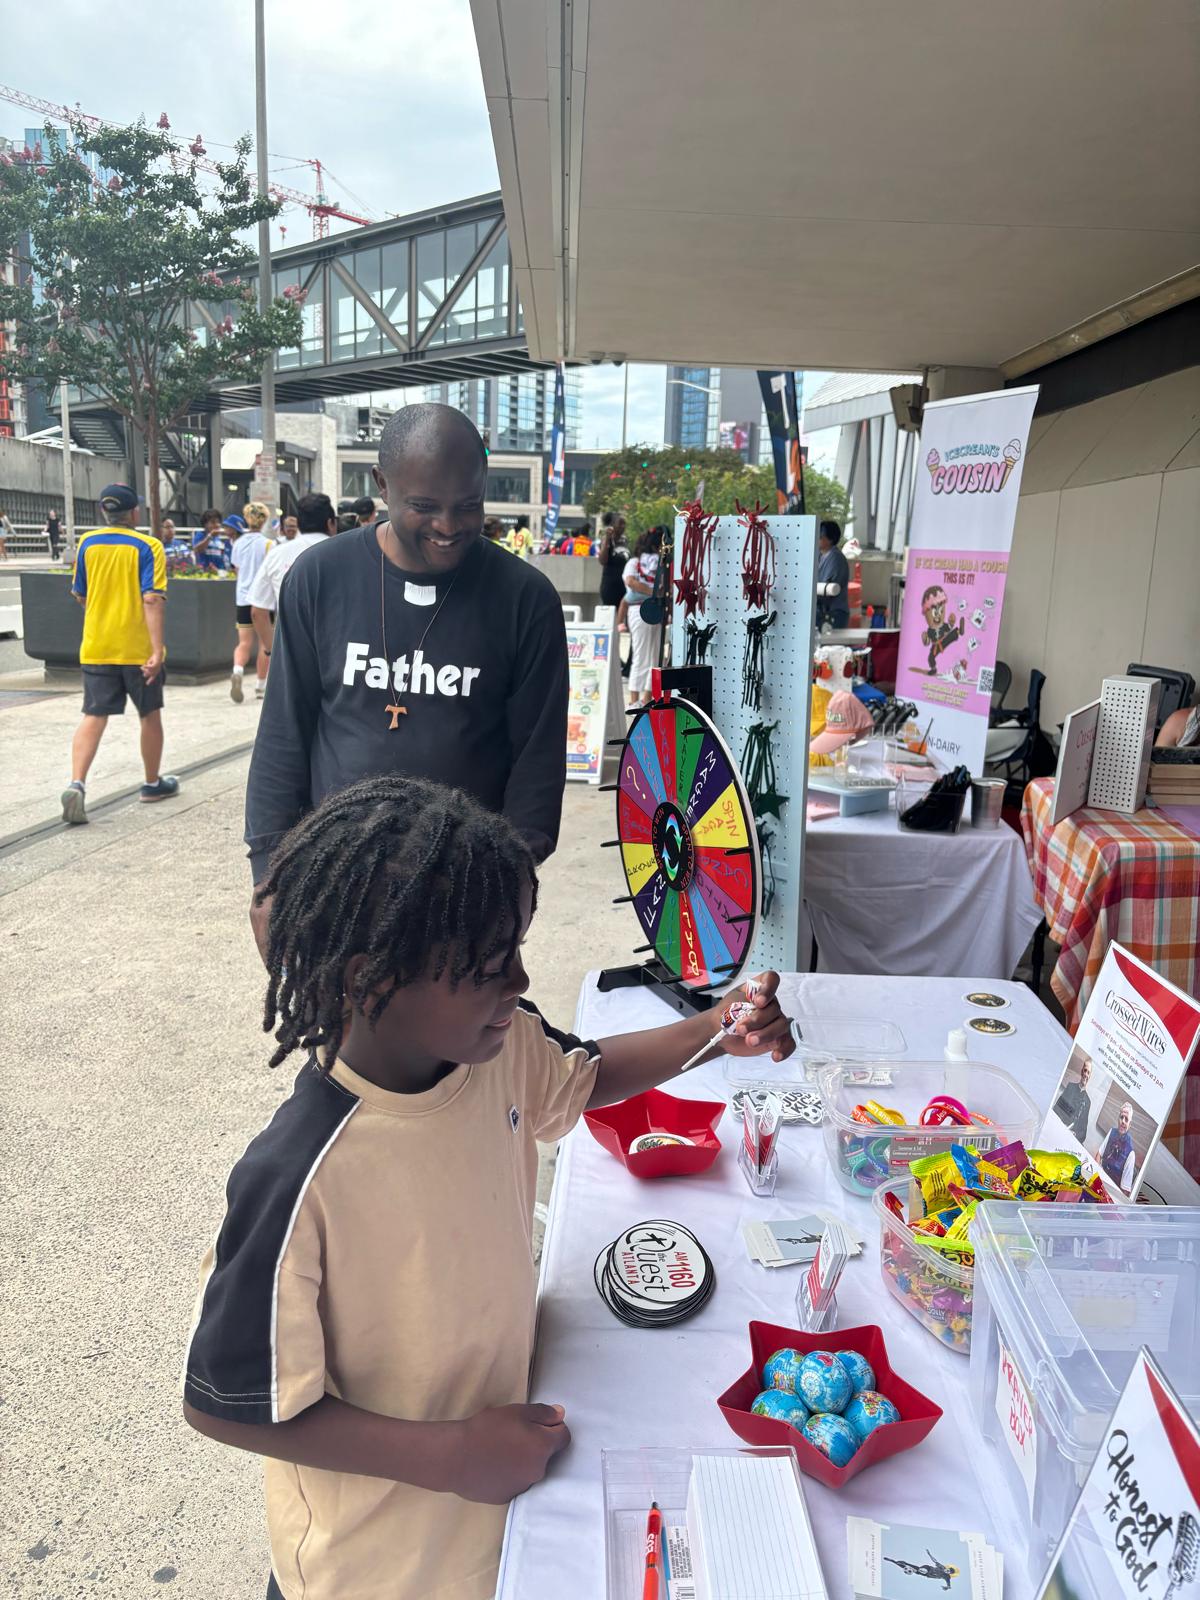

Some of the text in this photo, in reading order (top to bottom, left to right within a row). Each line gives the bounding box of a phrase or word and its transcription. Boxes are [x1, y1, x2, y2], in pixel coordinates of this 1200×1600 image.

[944, 444, 1000, 462] ICECREAM'S
[931, 462, 1007, 495] COUSIN
[943, 572, 958, 584] THIS
[958, 573, 966, 585] IS
[342, 642, 481, 697] Father
[927, 736, 961, 755] N-DAIRY
[721, 799, 740, 838] SPIN
[1105, 989, 1142, 1031] Crossed
[1140, 1014, 1167, 1055] Wires
[621, 1251, 640, 1285] ATLANTA
[625, 1227, 676, 1292] Quest
[657, 1252, 665, 1262] the
[666, 1251, 696, 1288] AM 1160
[1103, 1490, 1121, 1523] to
[1106, 1429, 1174, 1556] Honest
[1115, 1515, 1158, 1594] God
